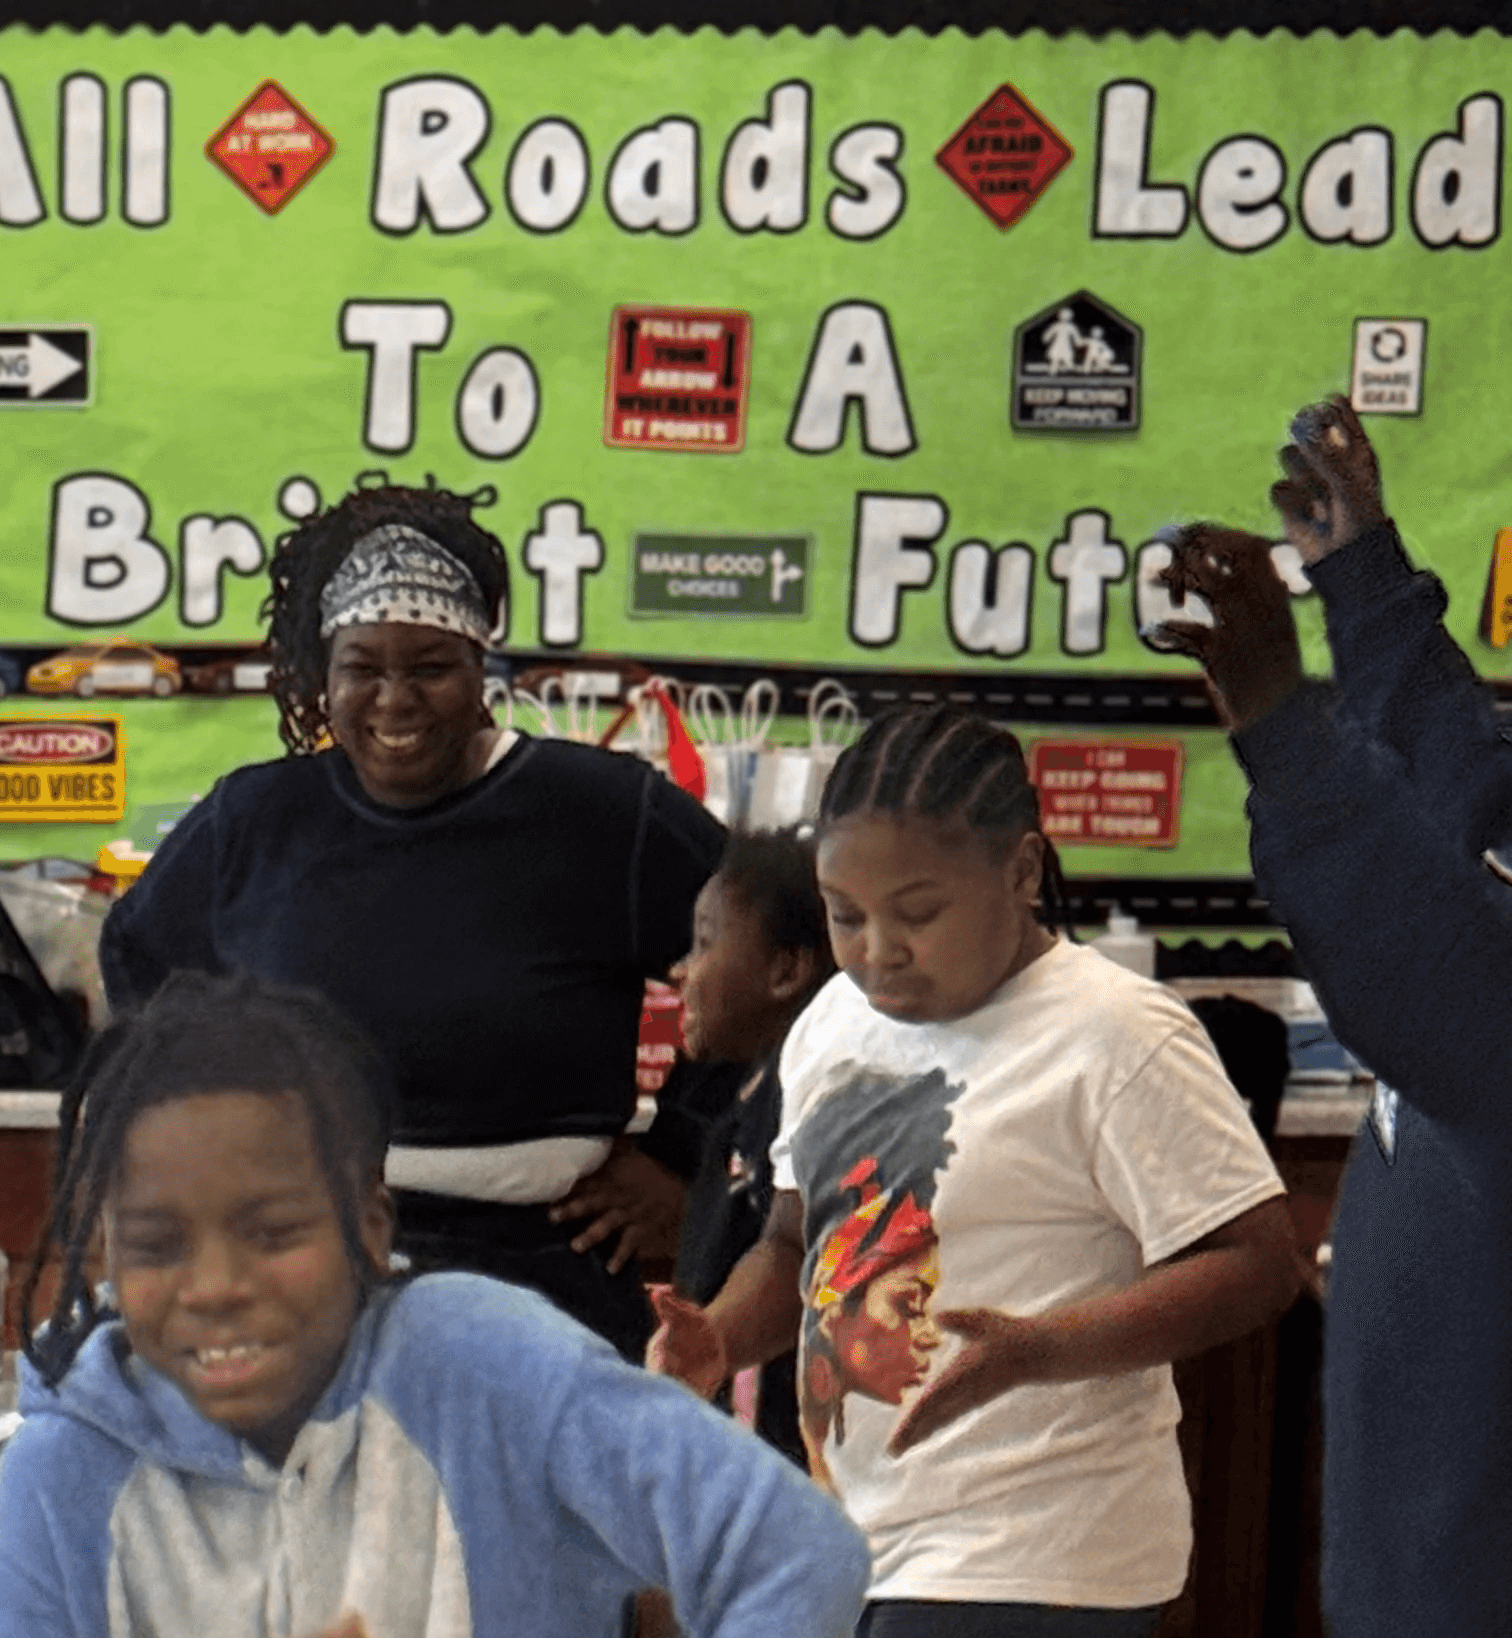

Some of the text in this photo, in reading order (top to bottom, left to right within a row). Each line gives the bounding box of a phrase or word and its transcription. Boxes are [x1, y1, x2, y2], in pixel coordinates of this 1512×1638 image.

[370, 73, 907, 241] Roads
[1090, 77, 1504, 254] Lead
[639, 318, 724, 340] FOLLOW
[337, 298, 919, 462] To A
[639, 368, 718, 390] ARROW
[1360, 371, 1411, 388] SHARE
[617, 395, 736, 415] WHEREVER
[1024, 387, 1064, 404] KEEP
[621, 418, 727, 441] IT POINTS
[46, 471, 605, 650] Brt
[640, 552, 767, 577] MAKE GOOD
[46, 772, 117, 802] VIBES
